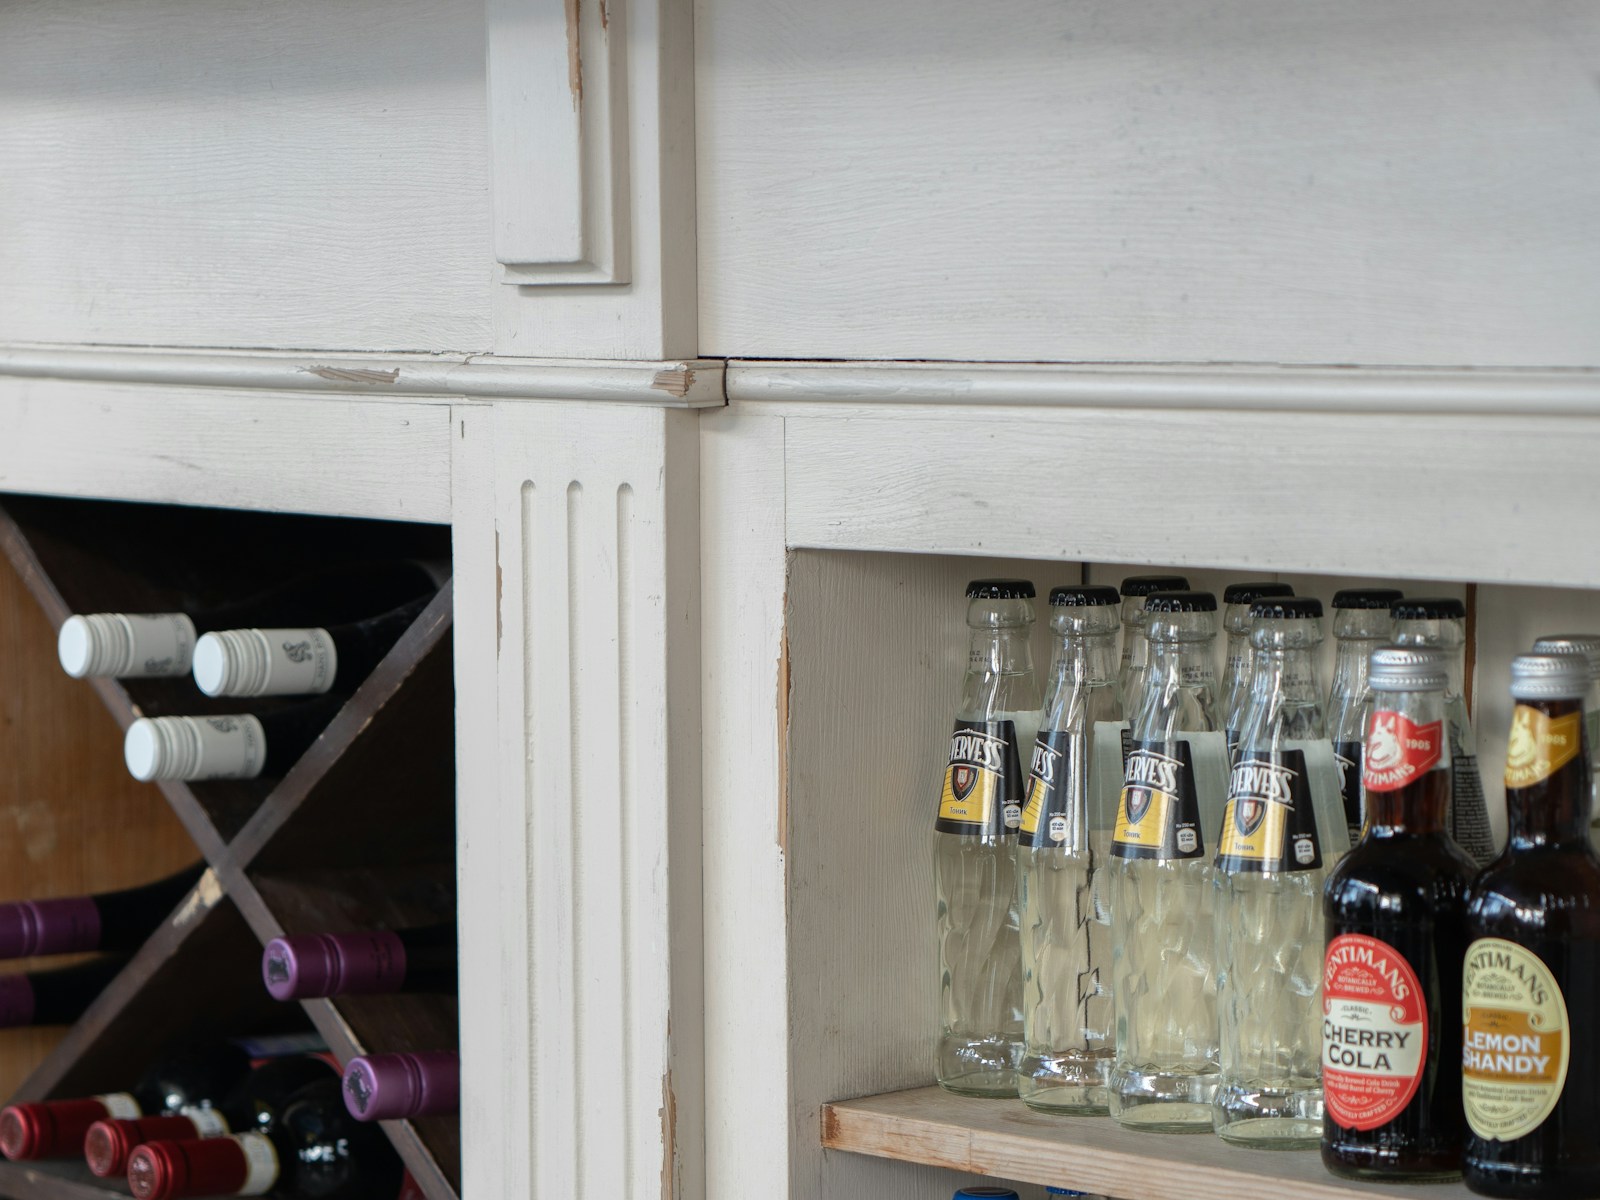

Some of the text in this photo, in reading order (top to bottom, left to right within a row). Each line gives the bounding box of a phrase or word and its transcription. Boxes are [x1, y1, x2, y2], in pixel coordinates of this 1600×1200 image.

[1406, 738, 1431, 751] 1905
[950, 806, 968, 816] Тоник
[1123, 829, 1141, 839] Тоник
[1234, 842, 1255, 851] Тоник
[1324, 1019, 1411, 1049] CHERRY
[1464, 1026, 1541, 1054] LEMON
[1329, 1043, 1392, 1071] COLA
[1463, 1046, 1550, 1074] SHANDY
